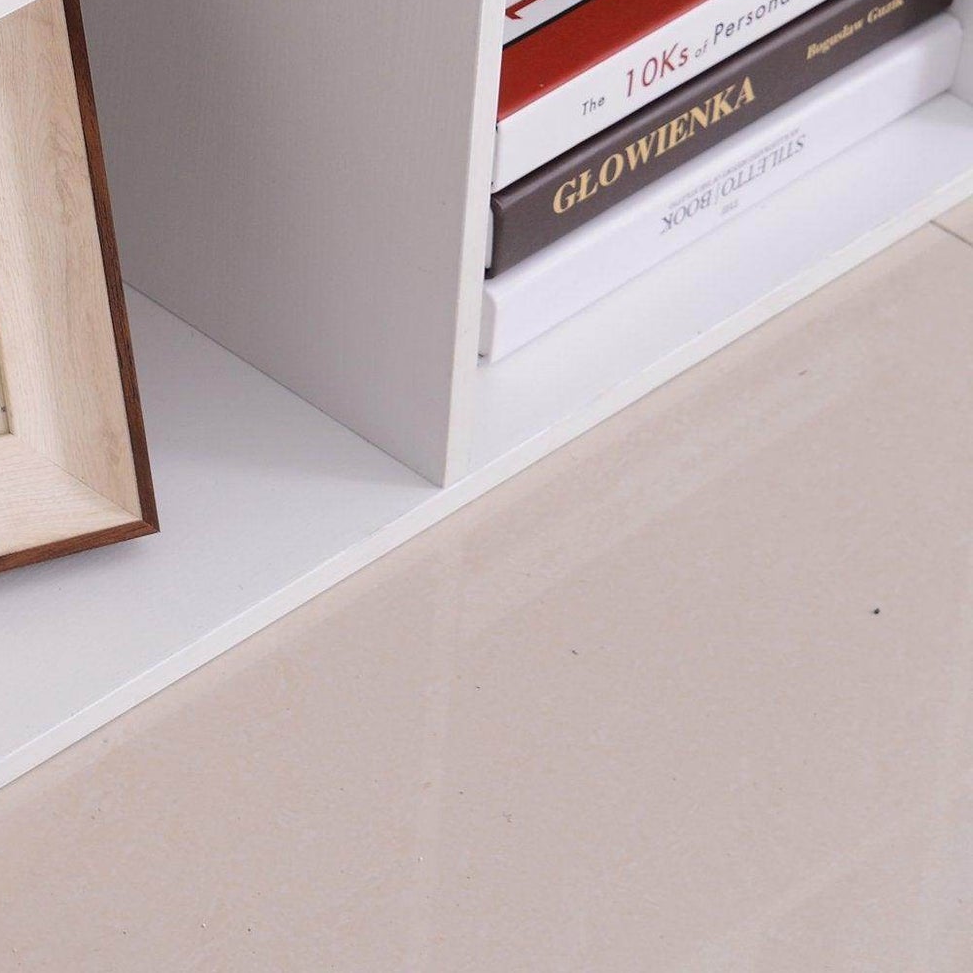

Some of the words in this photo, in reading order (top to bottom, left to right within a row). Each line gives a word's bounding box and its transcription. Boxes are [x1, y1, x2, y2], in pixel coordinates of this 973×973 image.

[581, 94, 606, 116] The
[625, 42, 689, 98] 10Ks
[695, 39, 709, 59] of
